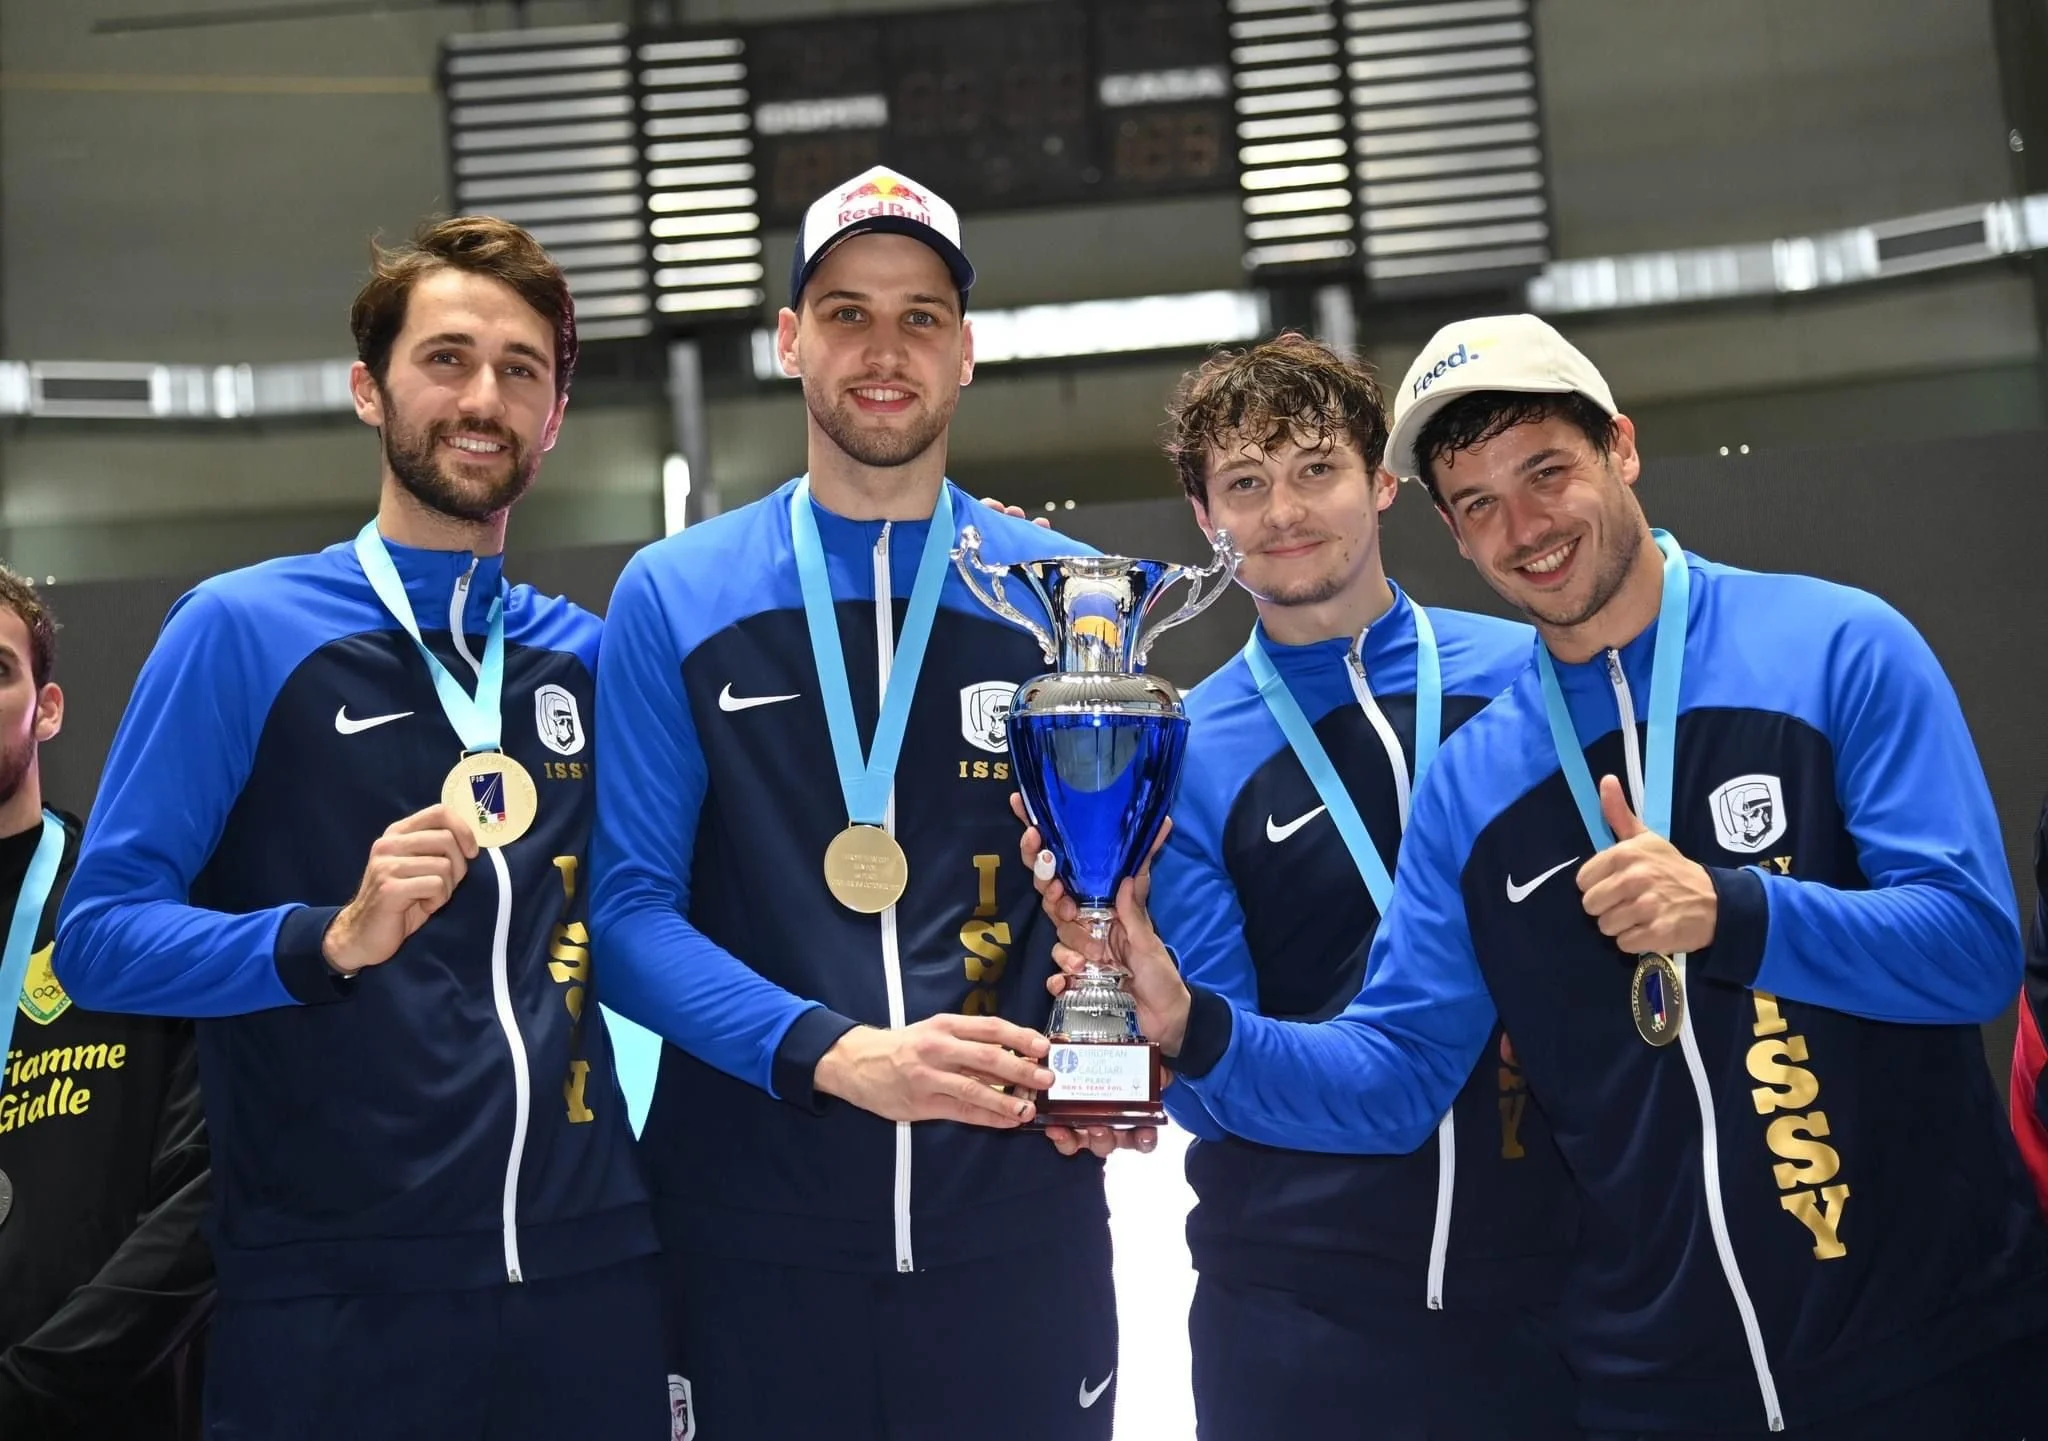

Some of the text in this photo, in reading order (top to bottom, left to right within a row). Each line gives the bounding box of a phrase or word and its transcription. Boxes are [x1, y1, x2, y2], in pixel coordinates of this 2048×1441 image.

[837, 201, 932, 227] Red Bull
[1412, 343, 1480, 400] Feed.
[959, 760, 1009, 780] ISS
[1078, 1048, 1128, 1058] EUROPEAN
[0, 1077, 91, 1135] Gialle
[1745, 989, 1851, 1261] ISSY
